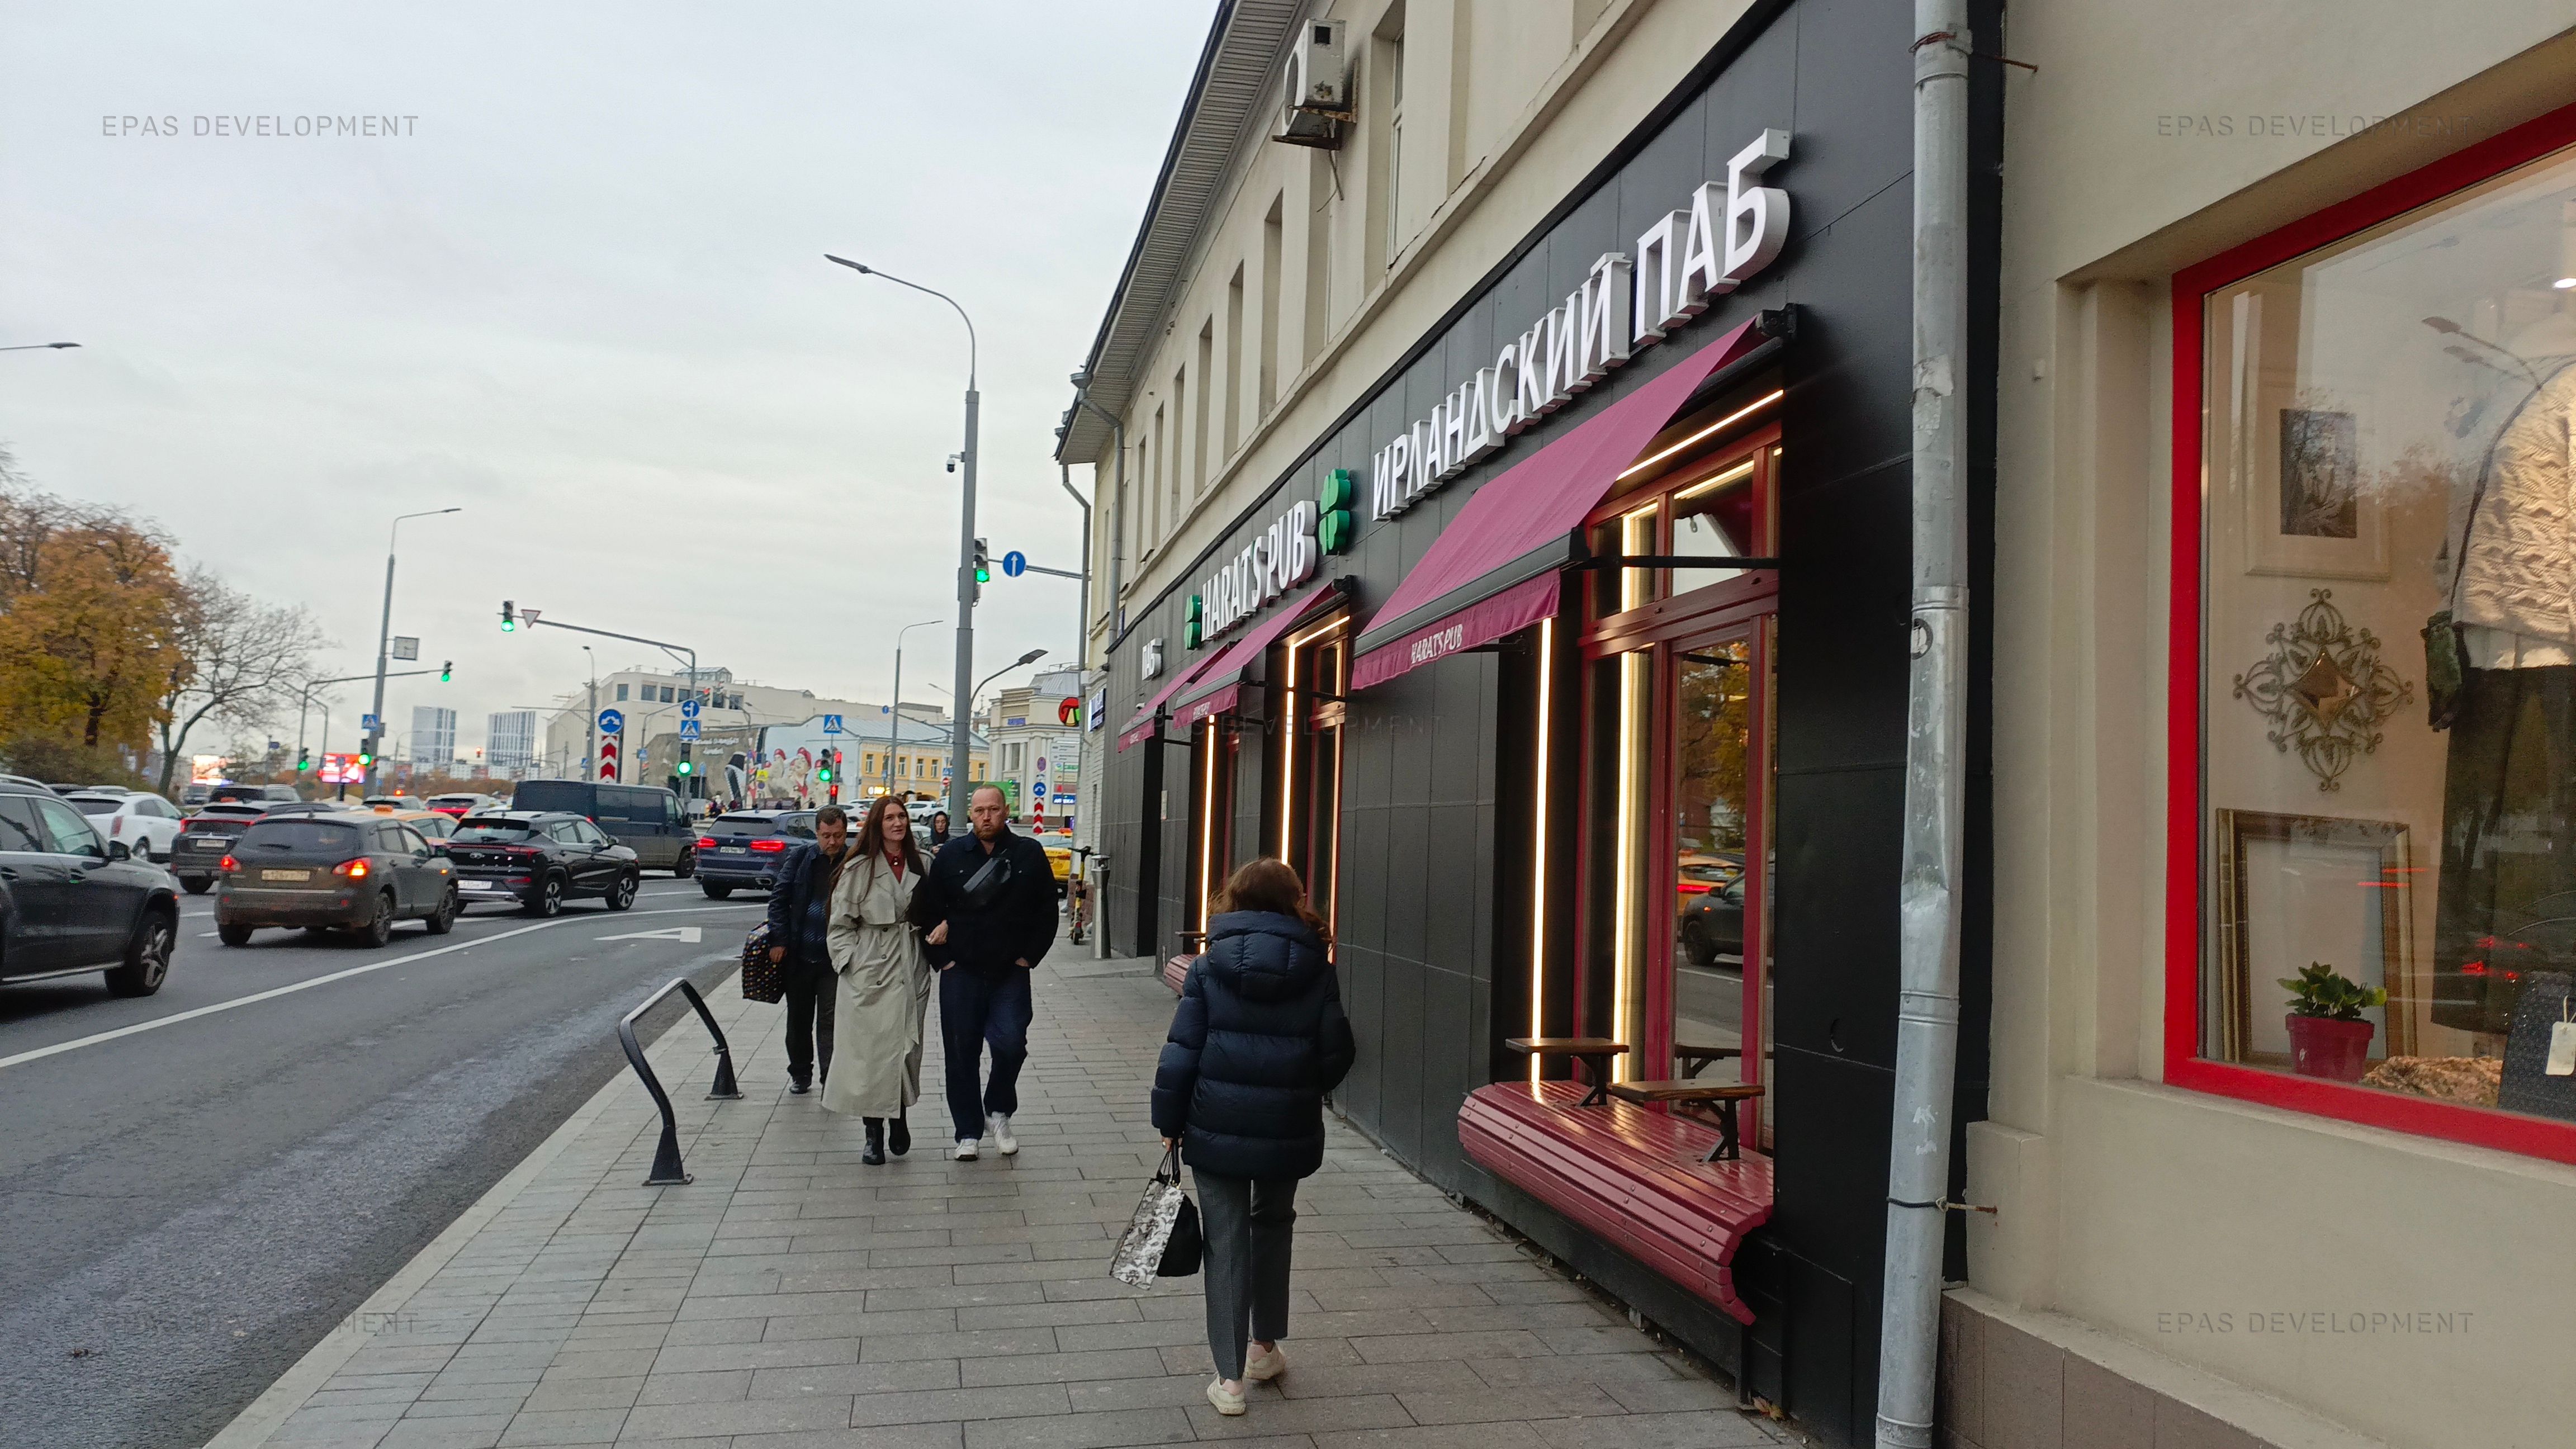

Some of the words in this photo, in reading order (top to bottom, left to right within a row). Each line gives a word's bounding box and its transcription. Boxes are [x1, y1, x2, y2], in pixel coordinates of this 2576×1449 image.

[1372, 253, 1632, 522] ИРЛАНДСКИЙ
[1633, 128, 1790, 344] ПАБ
[1266, 500, 1317, 598] PUB
[1443, 624, 1463, 652] PUB
